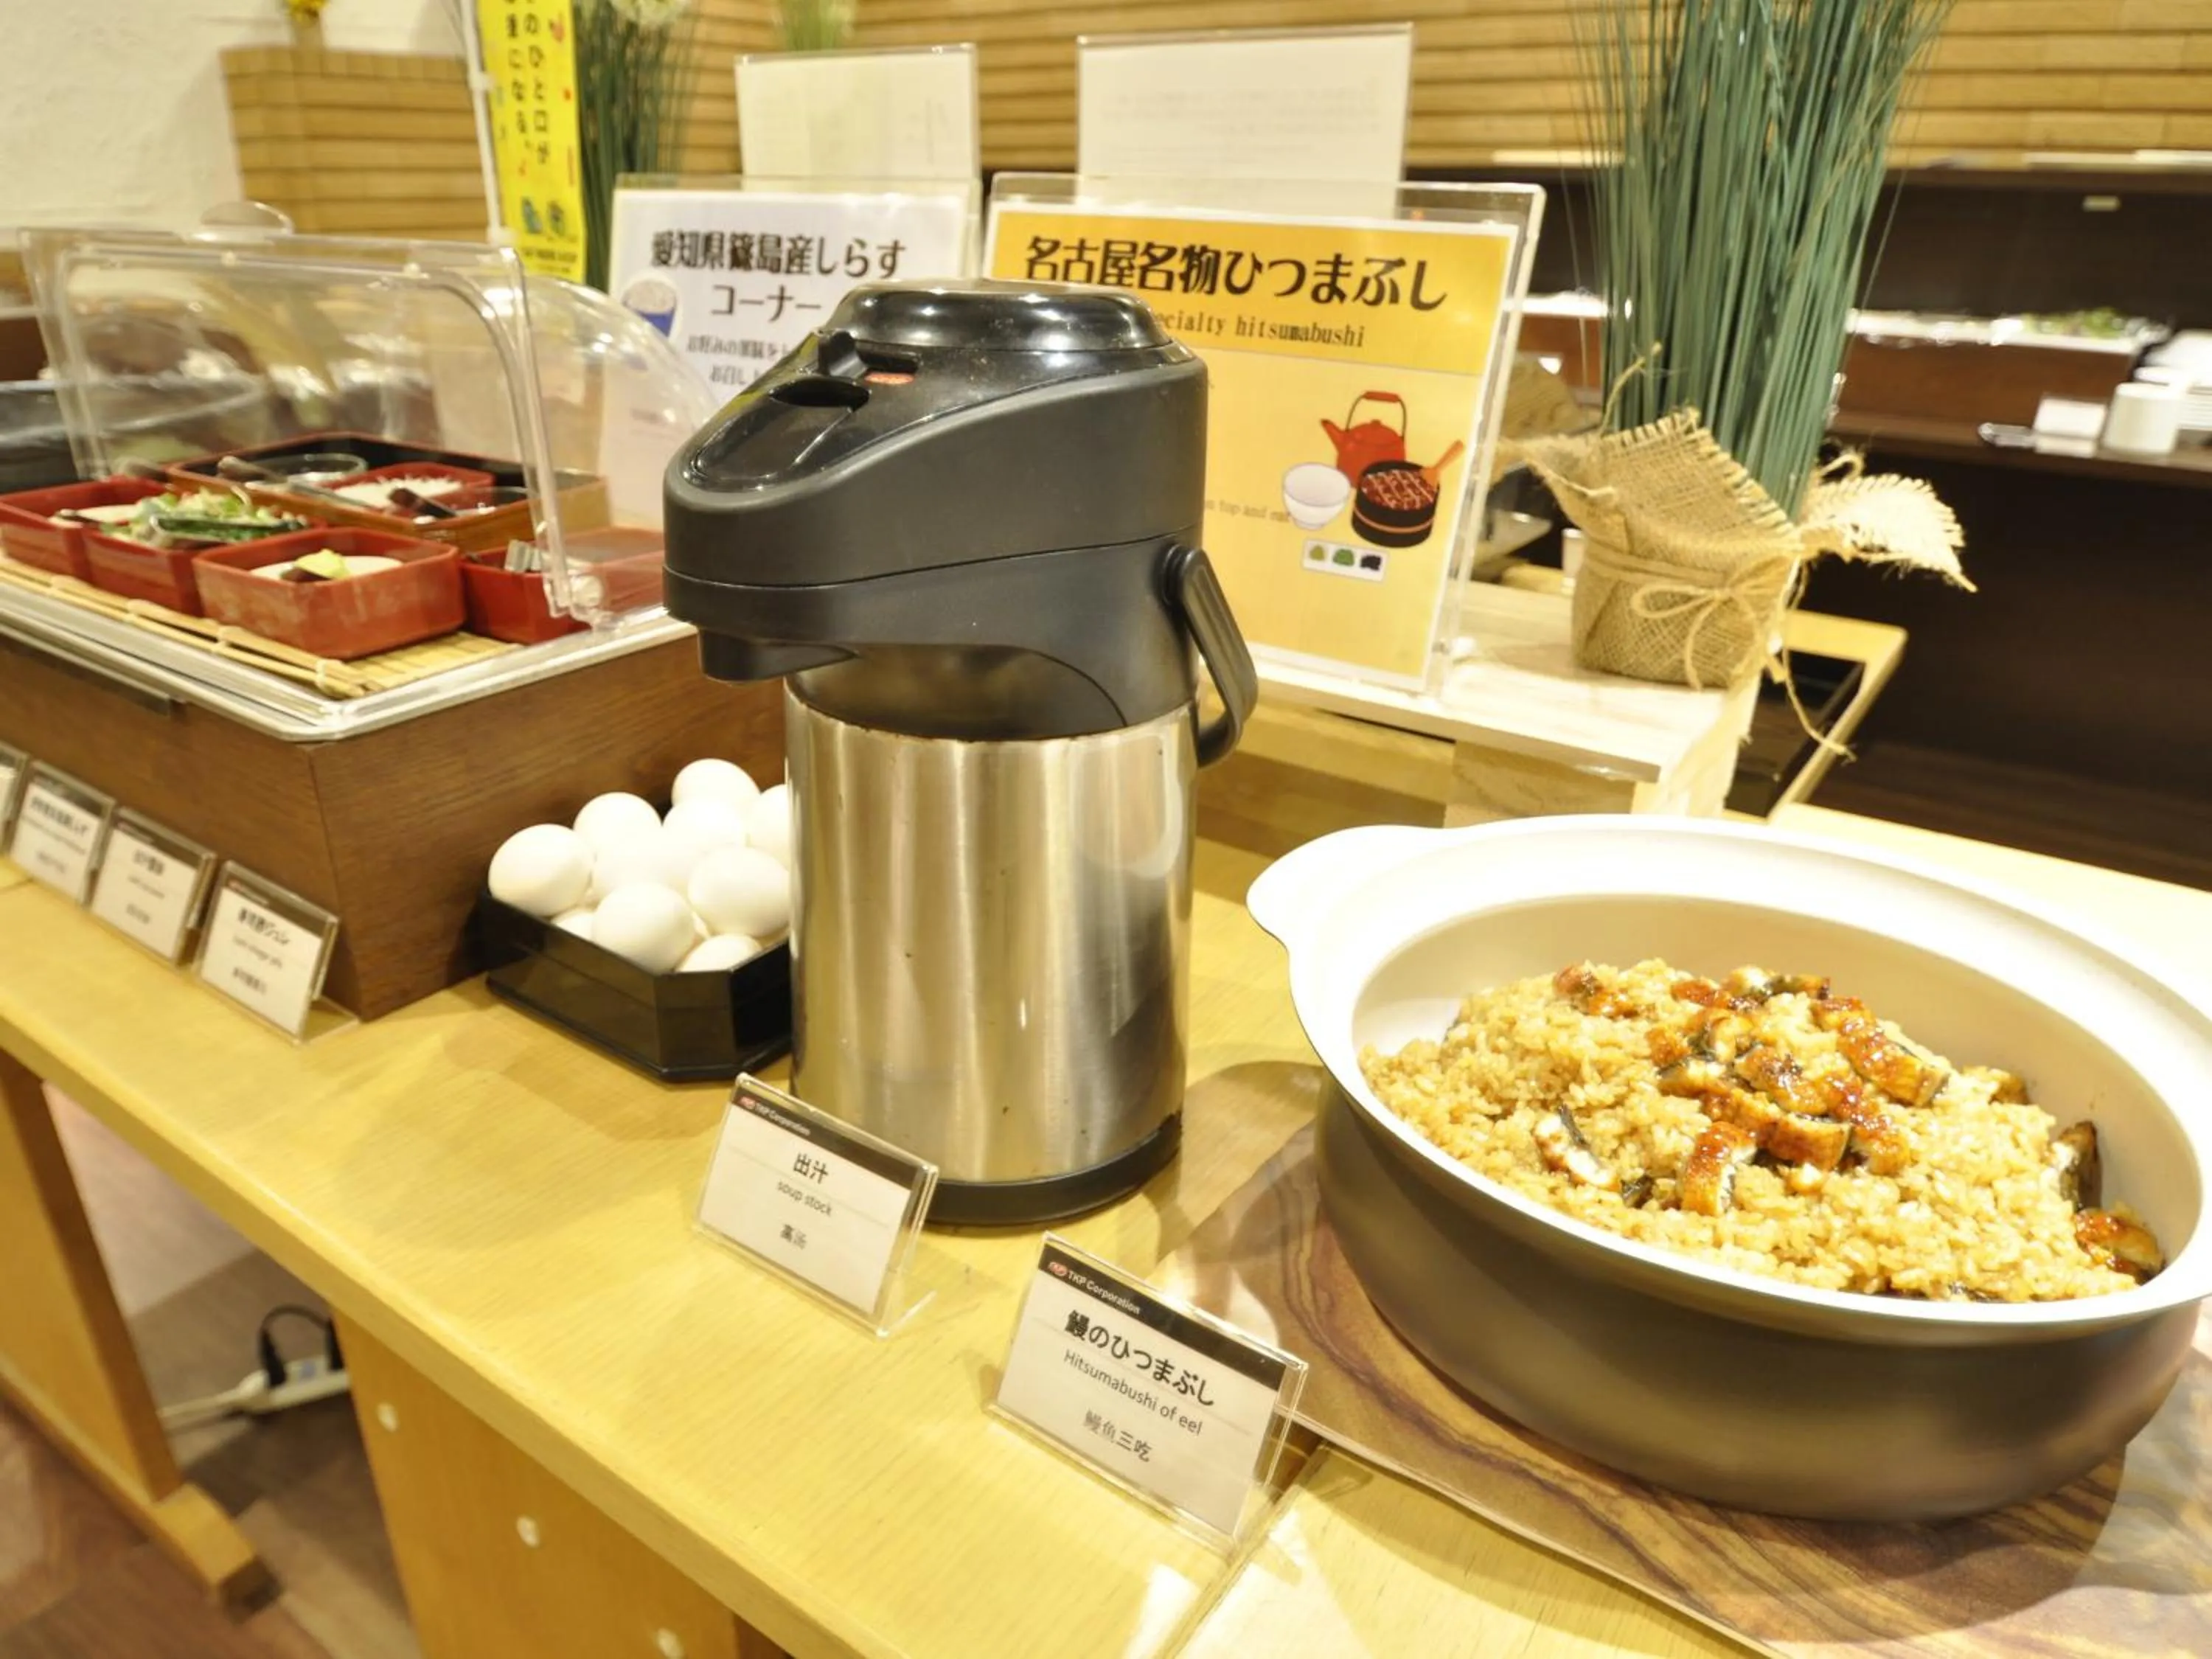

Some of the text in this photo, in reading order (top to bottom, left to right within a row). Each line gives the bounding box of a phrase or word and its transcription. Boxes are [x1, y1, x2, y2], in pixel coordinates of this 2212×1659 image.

[1026, 235, 1448, 311] 名古屋名物ひつまぶし
[711, 285, 821, 323] コーナー
[1155, 309, 1366, 348] ecialty hitsumabushi
[793, 1152, 829, 1184] 出汁
[776, 1180, 832, 1217] soup stock
[1068, 1270, 1141, 1315] TKP Corporation
[1065, 1310, 1214, 1406] 鰻のひつまぶし
[1063, 1349, 1203, 1436] Hitsumabushi of eel
